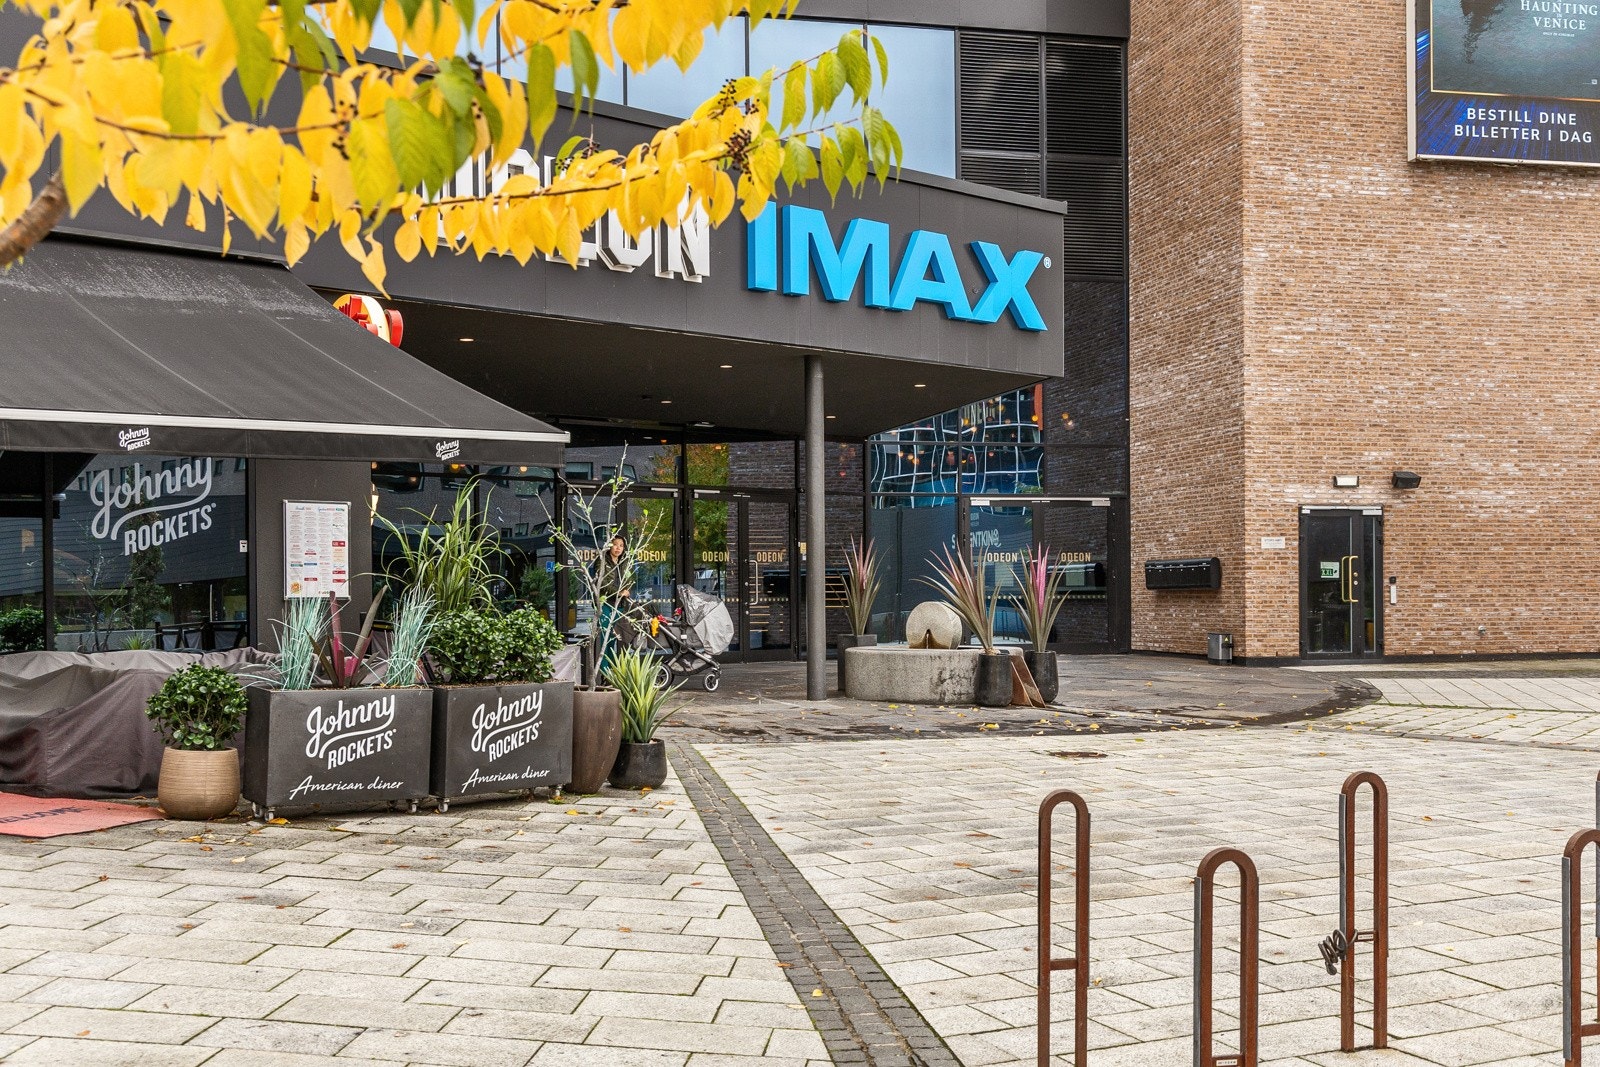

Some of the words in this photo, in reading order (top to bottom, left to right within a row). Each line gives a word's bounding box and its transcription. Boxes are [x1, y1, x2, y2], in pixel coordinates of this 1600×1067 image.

[1520, 0, 1598, 16] HAUNTING
[1533, 16, 1587, 30] VENICE
[1467, 108, 1532, 123] BESTILL
[1539, 112, 1577, 125] DINE
[1454, 125, 1540, 140] BILLETTER
[1548, 130, 1552, 141] I
[1559, 131, 1592, 143] DAG
[747, 200, 1048, 332] IMAX
[119, 427, 150, 447] Johnny
[127, 440, 150, 451] ROCKETS
[436, 440, 459, 457] Johnny
[90, 457, 212, 540] Johnny
[124, 504, 212, 556] ROCKETS
[637, 550, 667, 562] ODEON
[702, 551, 729, 562] ODEON
[756, 551, 783, 563] ODEON
[987, 552, 1018, 563] ODEON
[1061, 552, 1091, 562] ODEON
[305, 694, 395, 758] Johnny
[471, 689, 543, 752] Johnny
[327, 730, 394, 770] ROCKETS
[488, 723, 540, 762] ROCKETS
[289, 775, 364, 800] American
[367, 776, 403, 790] diner
[461, 768, 520, 793] American
[521, 766, 550, 779] diner
